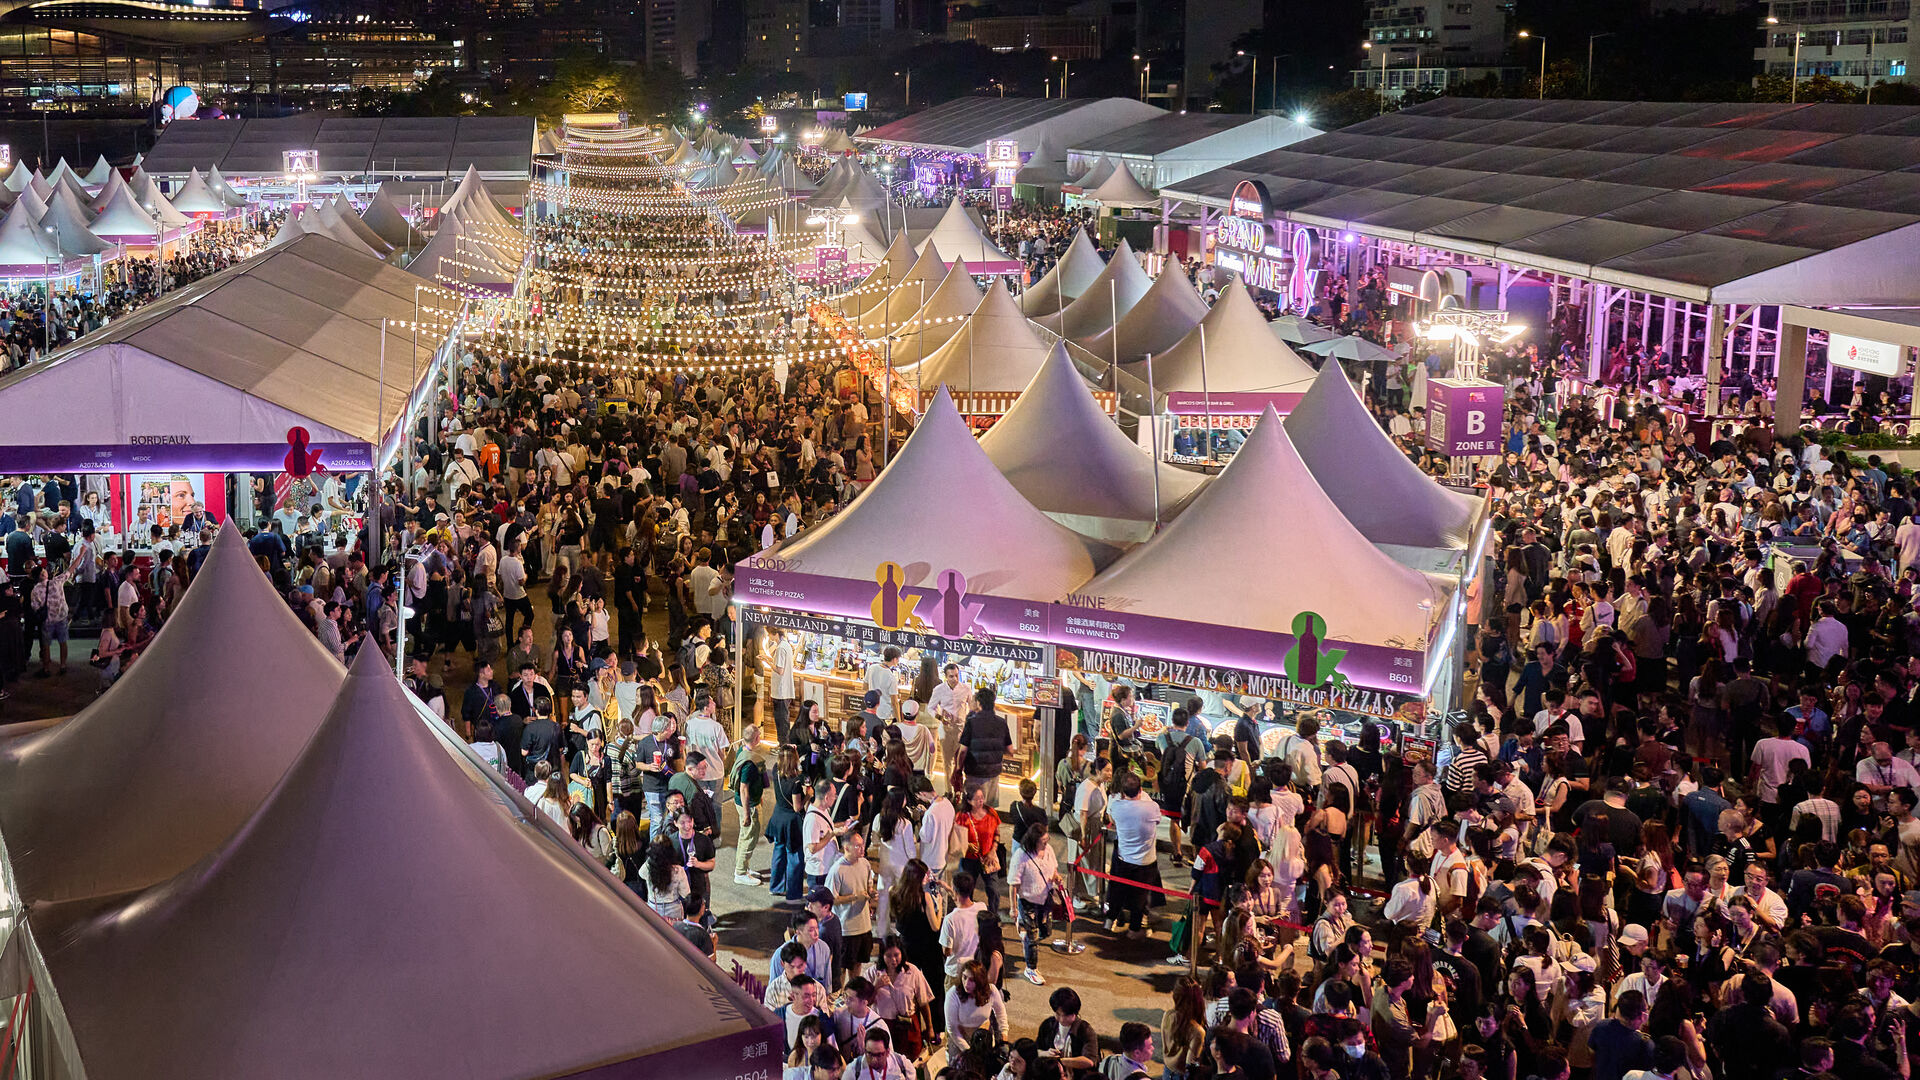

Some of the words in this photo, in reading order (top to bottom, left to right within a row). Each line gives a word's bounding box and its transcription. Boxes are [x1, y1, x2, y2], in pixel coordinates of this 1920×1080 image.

[999, 146, 1011, 160] B
[291, 157, 306, 173] A
[1000, 194, 1007, 204] B
[1217, 215, 1265, 254] GRAND
[1243, 252, 1284, 294] WINE
[1466, 410, 1486, 435] B
[130, 435, 192, 446] BORDEAUX
[1455, 441, 1484, 451] ZONE
[748, 556, 786, 572] FOOD
[748, 587, 775, 597] MOTHER
[775, 590, 784, 599] OF
[783, 591, 805, 601] PIZZAS
[1066, 593, 1106, 611] WINE
[1024, 608, 1040, 618] 美食
[744, 611, 772, 624] NEW
[774, 614, 829, 633] ZEALAND
[1019, 622, 1040, 633] B602
[1065, 626, 1086, 637] LEVIN
[1086, 629, 1105, 639] WINE
[1105, 631, 1120, 640] LTD
[943, 640, 973, 653] NEW
[976, 643, 1038, 661] ZEALAND
[1083, 650, 1141, 679] MOTHER
[1158, 660, 1218, 690] PIZZAS
[1389, 672, 1413, 684] B601
[1329, 686, 1396, 718] PIZZAS
[742, 1041, 769, 1061] 美酒
